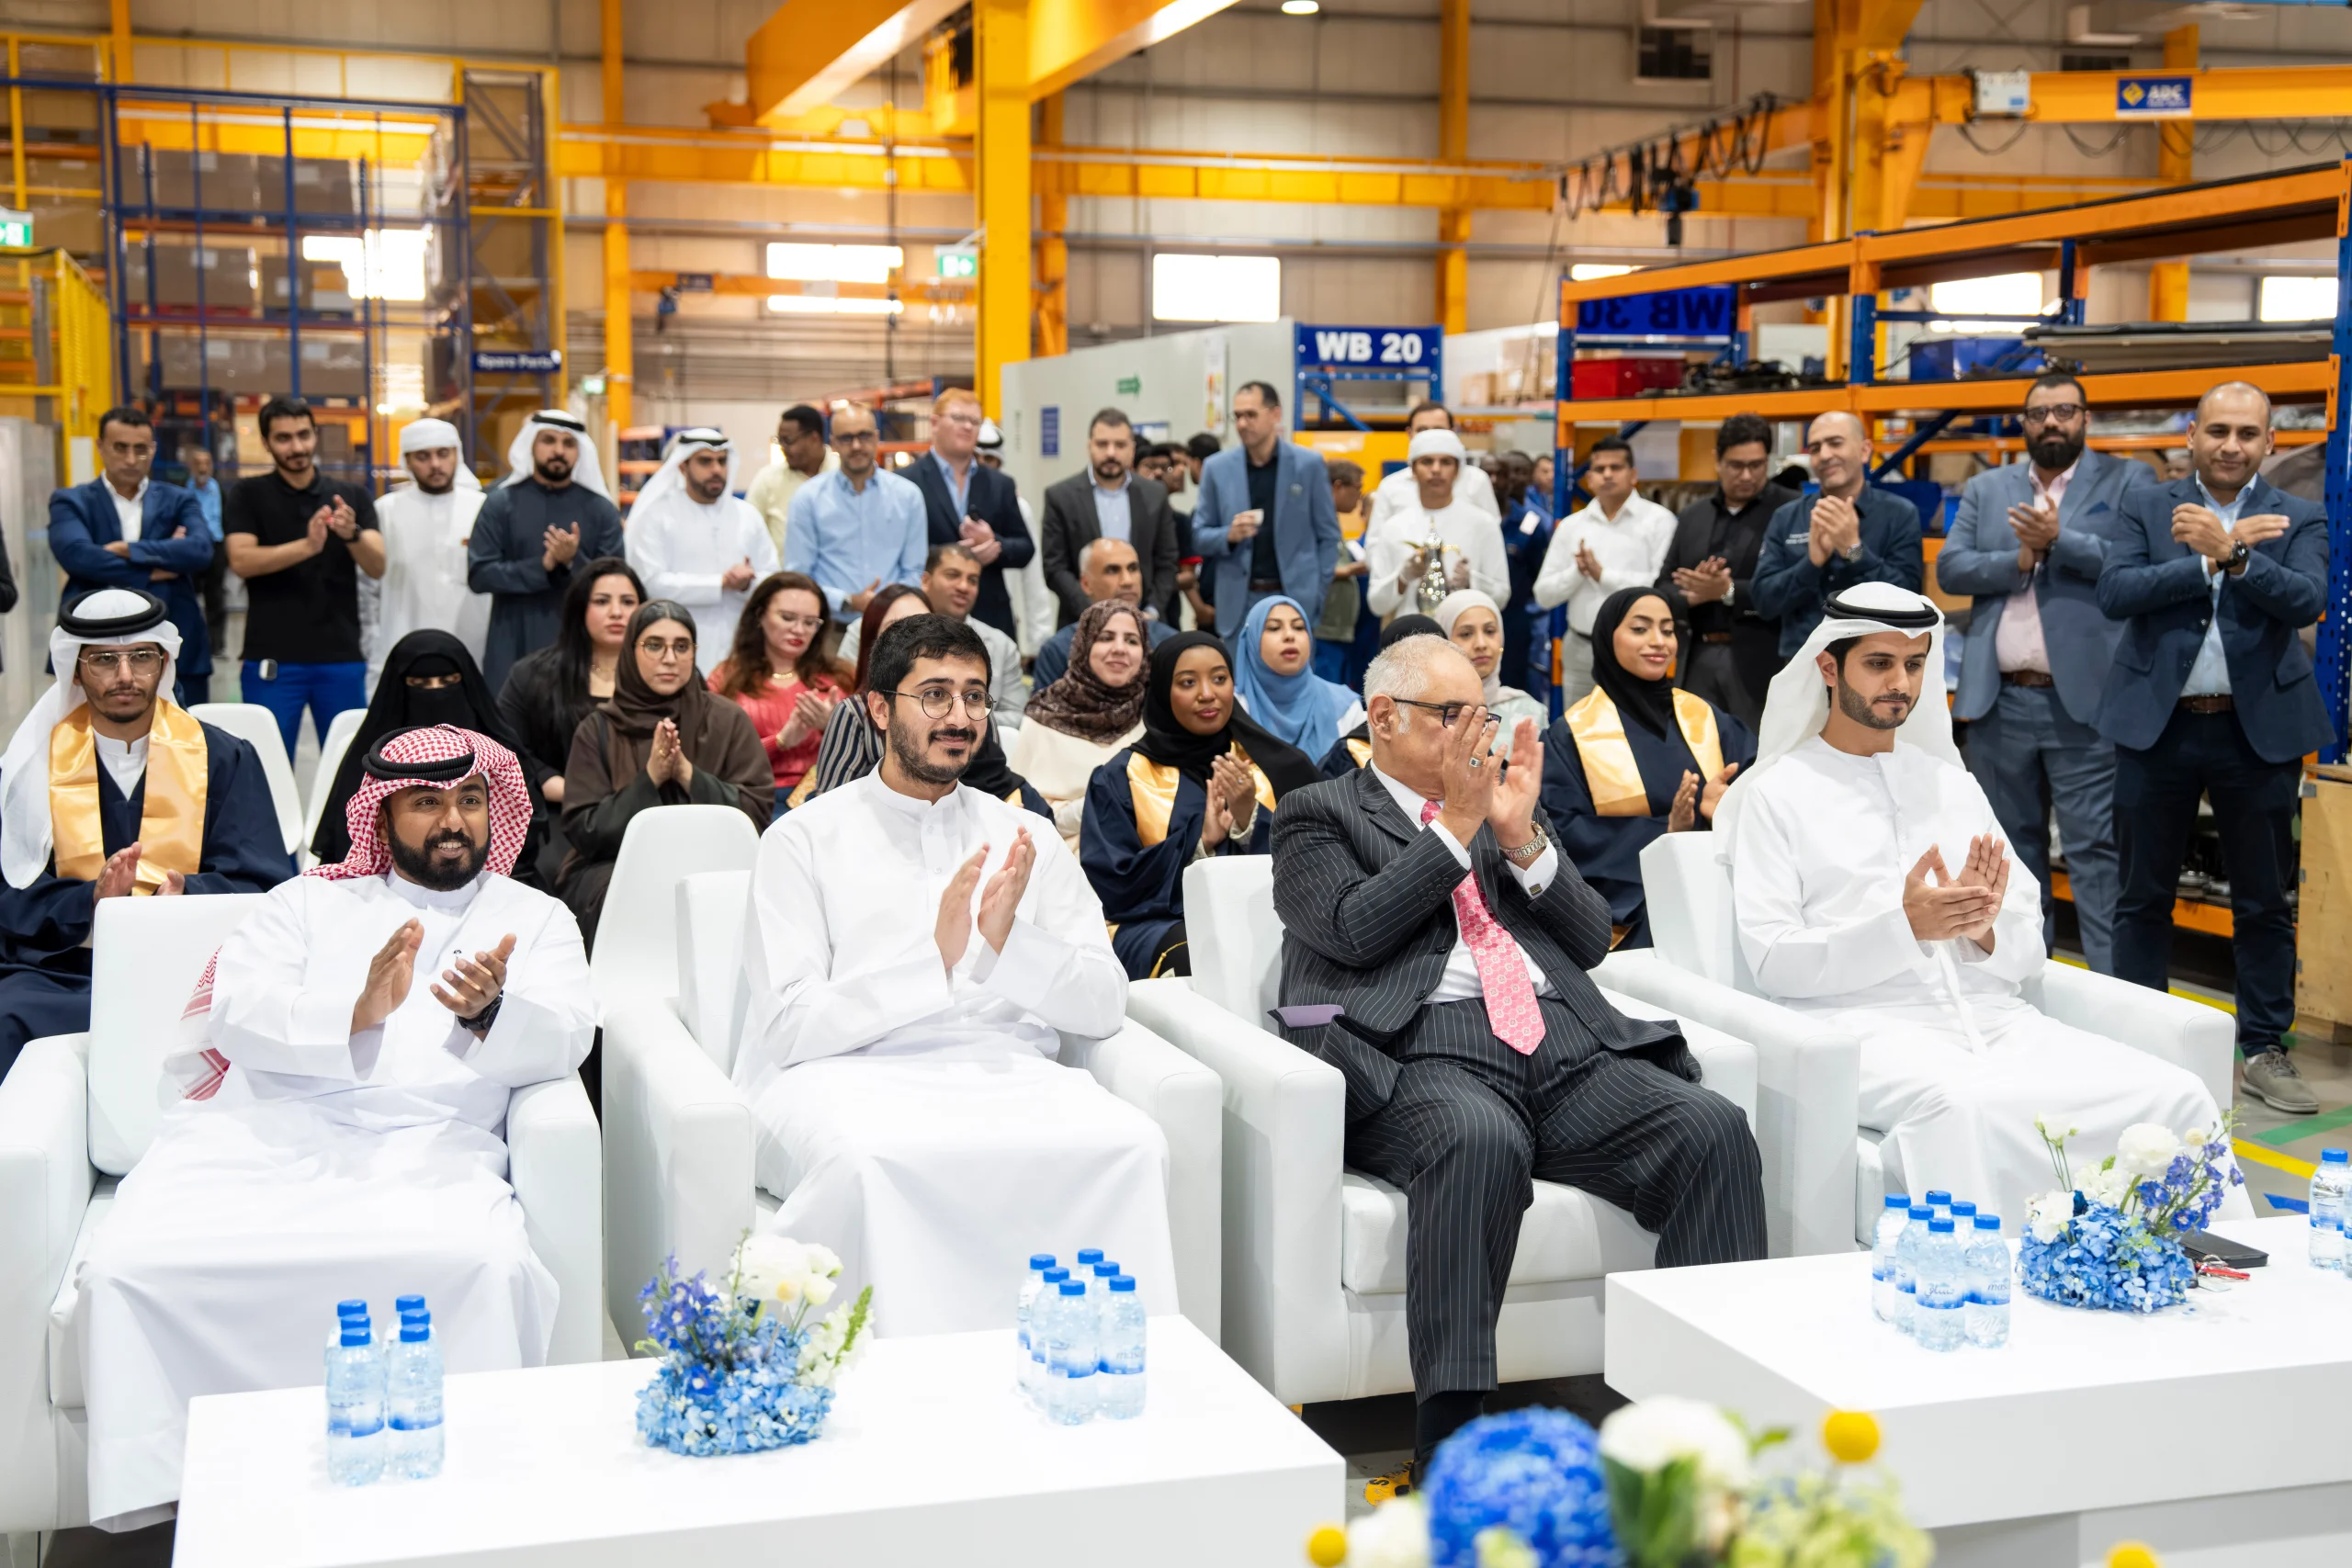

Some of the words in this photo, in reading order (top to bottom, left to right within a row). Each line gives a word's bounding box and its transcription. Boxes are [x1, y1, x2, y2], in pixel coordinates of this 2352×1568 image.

[1316, 331, 1373, 363] WB
[1380, 332, 1423, 364] 20
[476, 354, 517, 370] Spare
[518, 354, 554, 369] Parts
